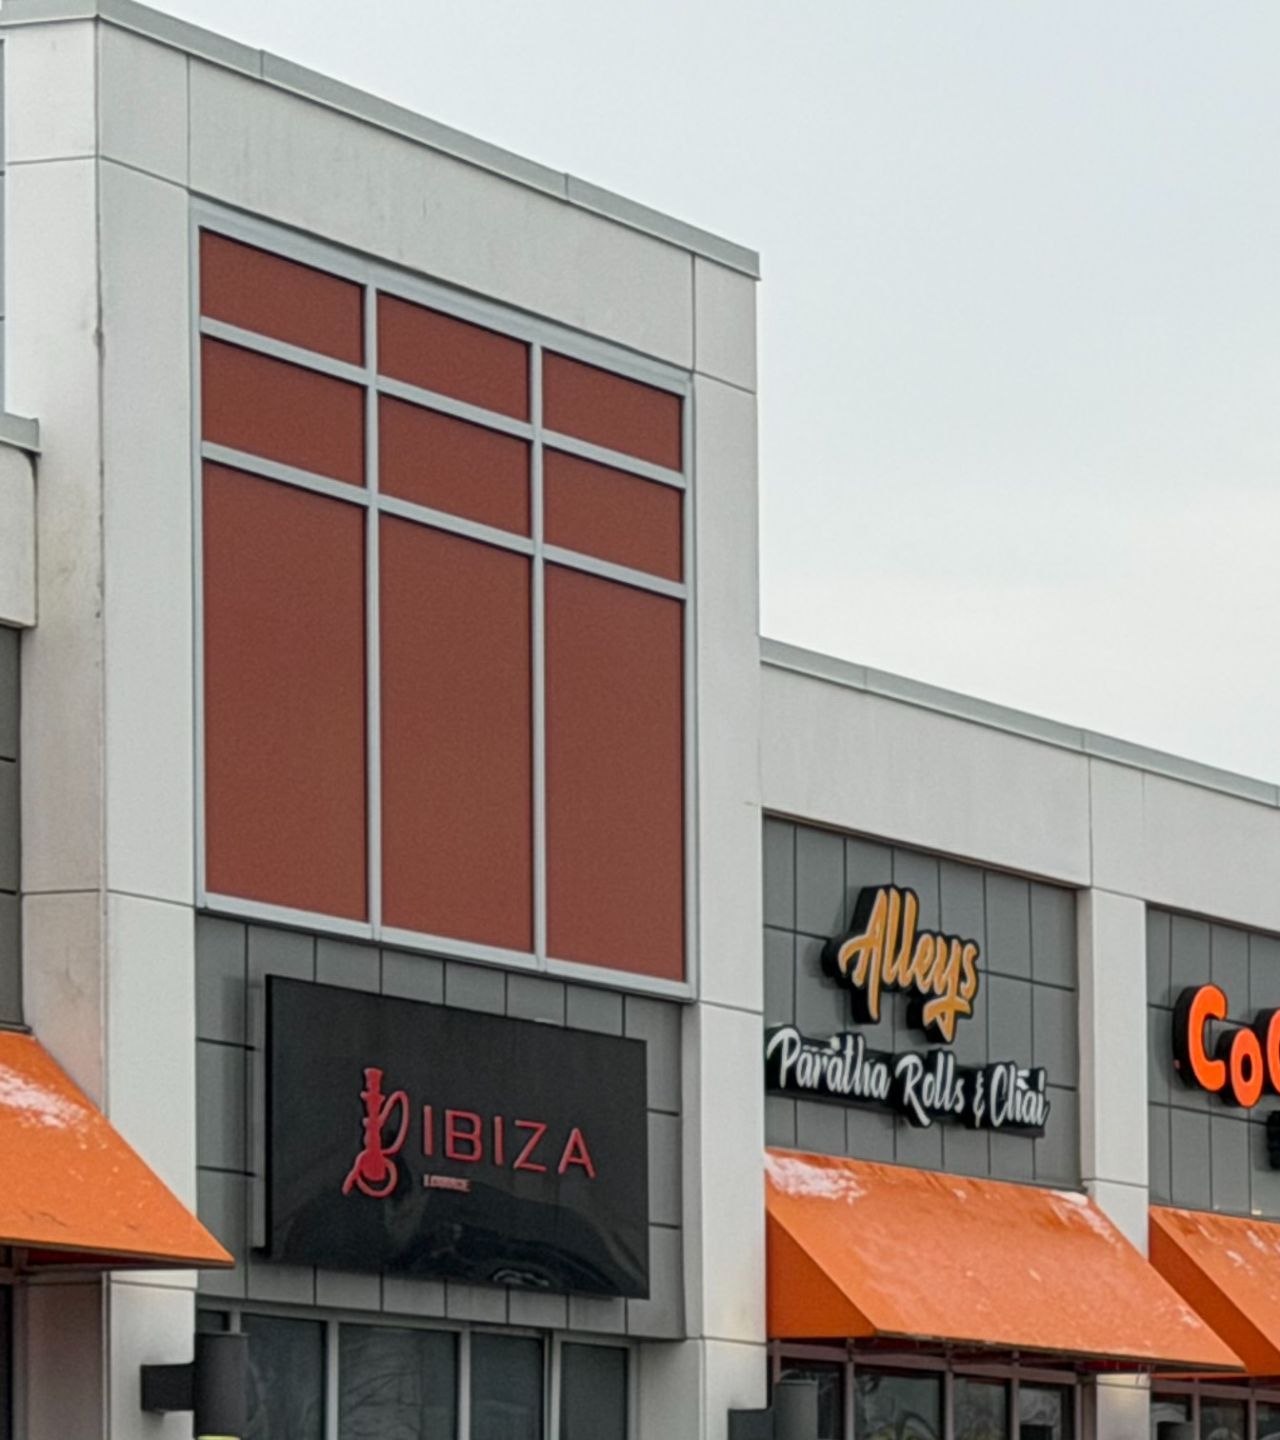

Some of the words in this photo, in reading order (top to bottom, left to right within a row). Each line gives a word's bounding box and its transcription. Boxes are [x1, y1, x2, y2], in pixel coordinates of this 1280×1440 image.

[837, 886, 979, 1043] Alleys
[895, 1050, 964, 1127] Rolls
[422, 1104, 597, 1179] IBIZA
